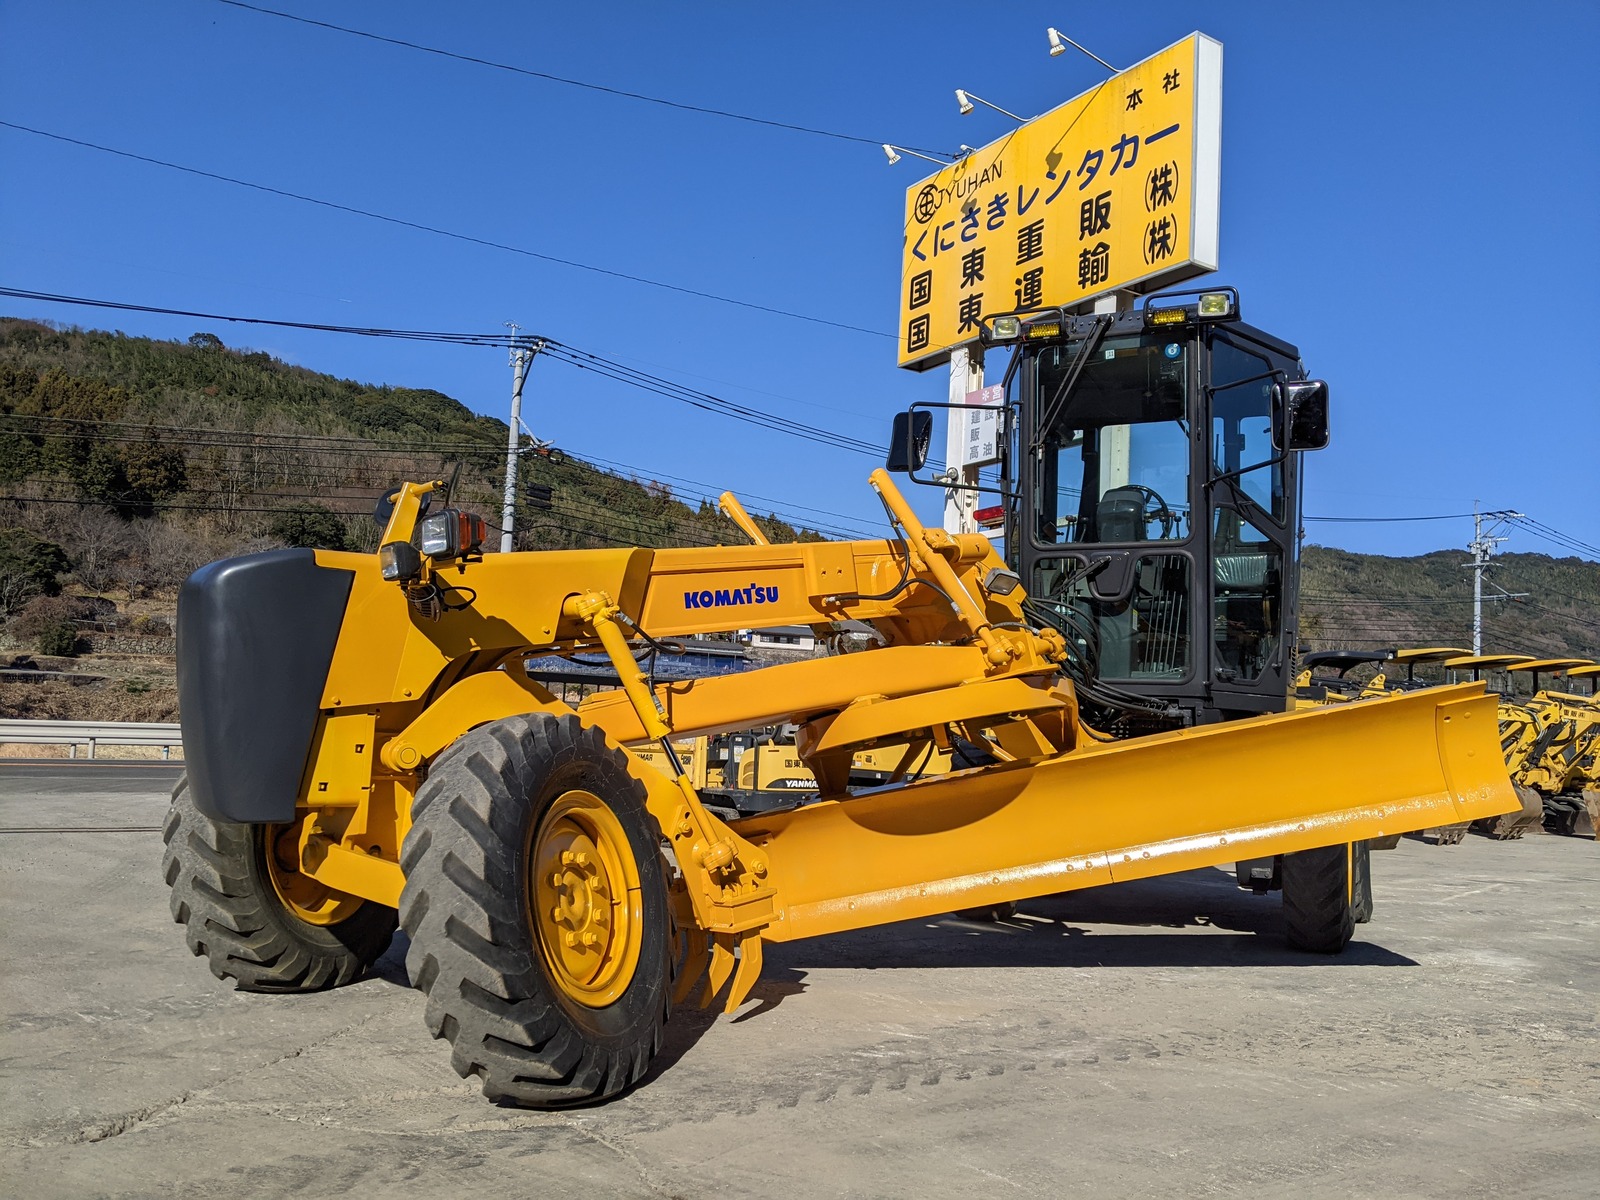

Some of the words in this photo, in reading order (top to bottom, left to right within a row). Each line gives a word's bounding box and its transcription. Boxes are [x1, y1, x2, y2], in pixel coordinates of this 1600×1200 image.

[1126, 68, 1180, 111] 本社
[912, 123, 1180, 261] くにさきレンタカー
[934, 160, 1003, 210] JYUHAN
[684, 583, 778, 609] KOMATSU
[785, 780, 819, 788] YANMA
